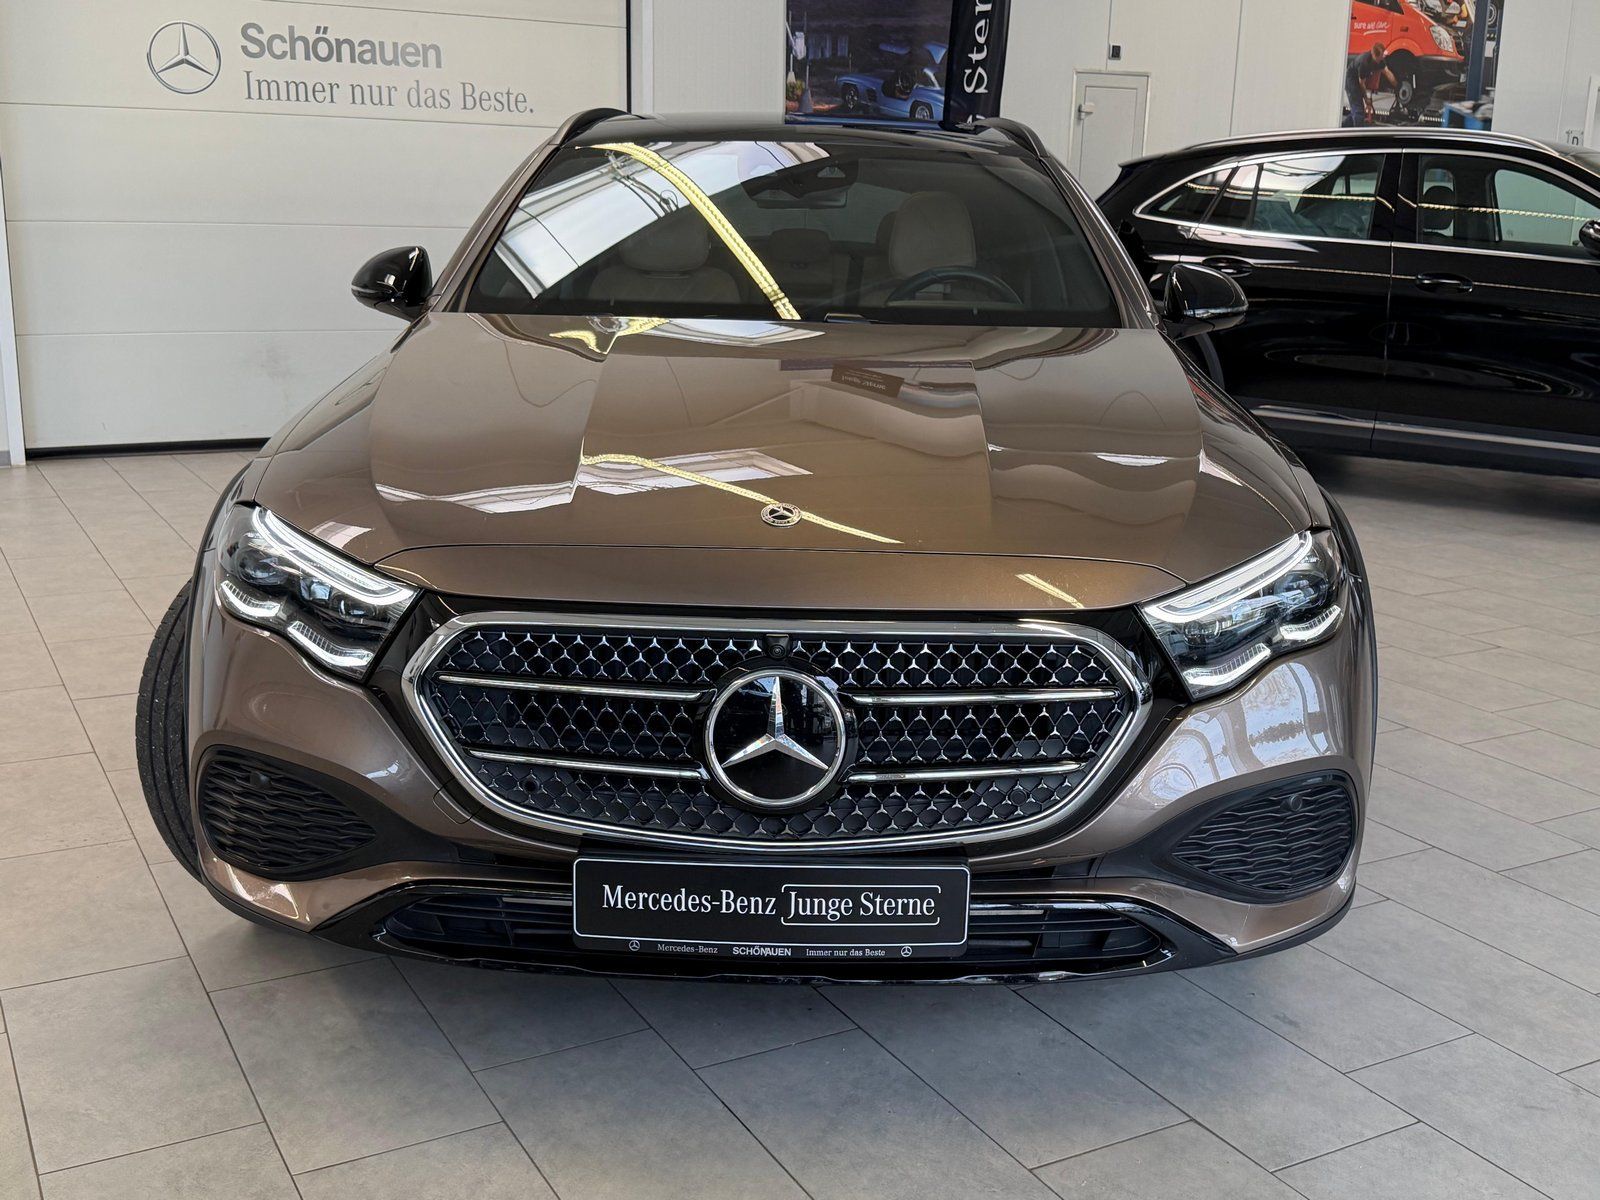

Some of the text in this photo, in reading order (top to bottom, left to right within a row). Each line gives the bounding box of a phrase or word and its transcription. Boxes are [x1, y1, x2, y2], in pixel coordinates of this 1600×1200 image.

[240, 22, 443, 69] Schönauen
[243, 70, 534, 114] Immer nur das Beste.
[601, 884, 935, 922] Mercedes-Benz Junge Sterne
[657, 943, 719, 955] Mercedes-Benz
[805, 948, 832, 957] Immer
[833, 949, 848, 957] nur
[849, 948, 864, 957] das
[864, 948, 886, 957] Beste
